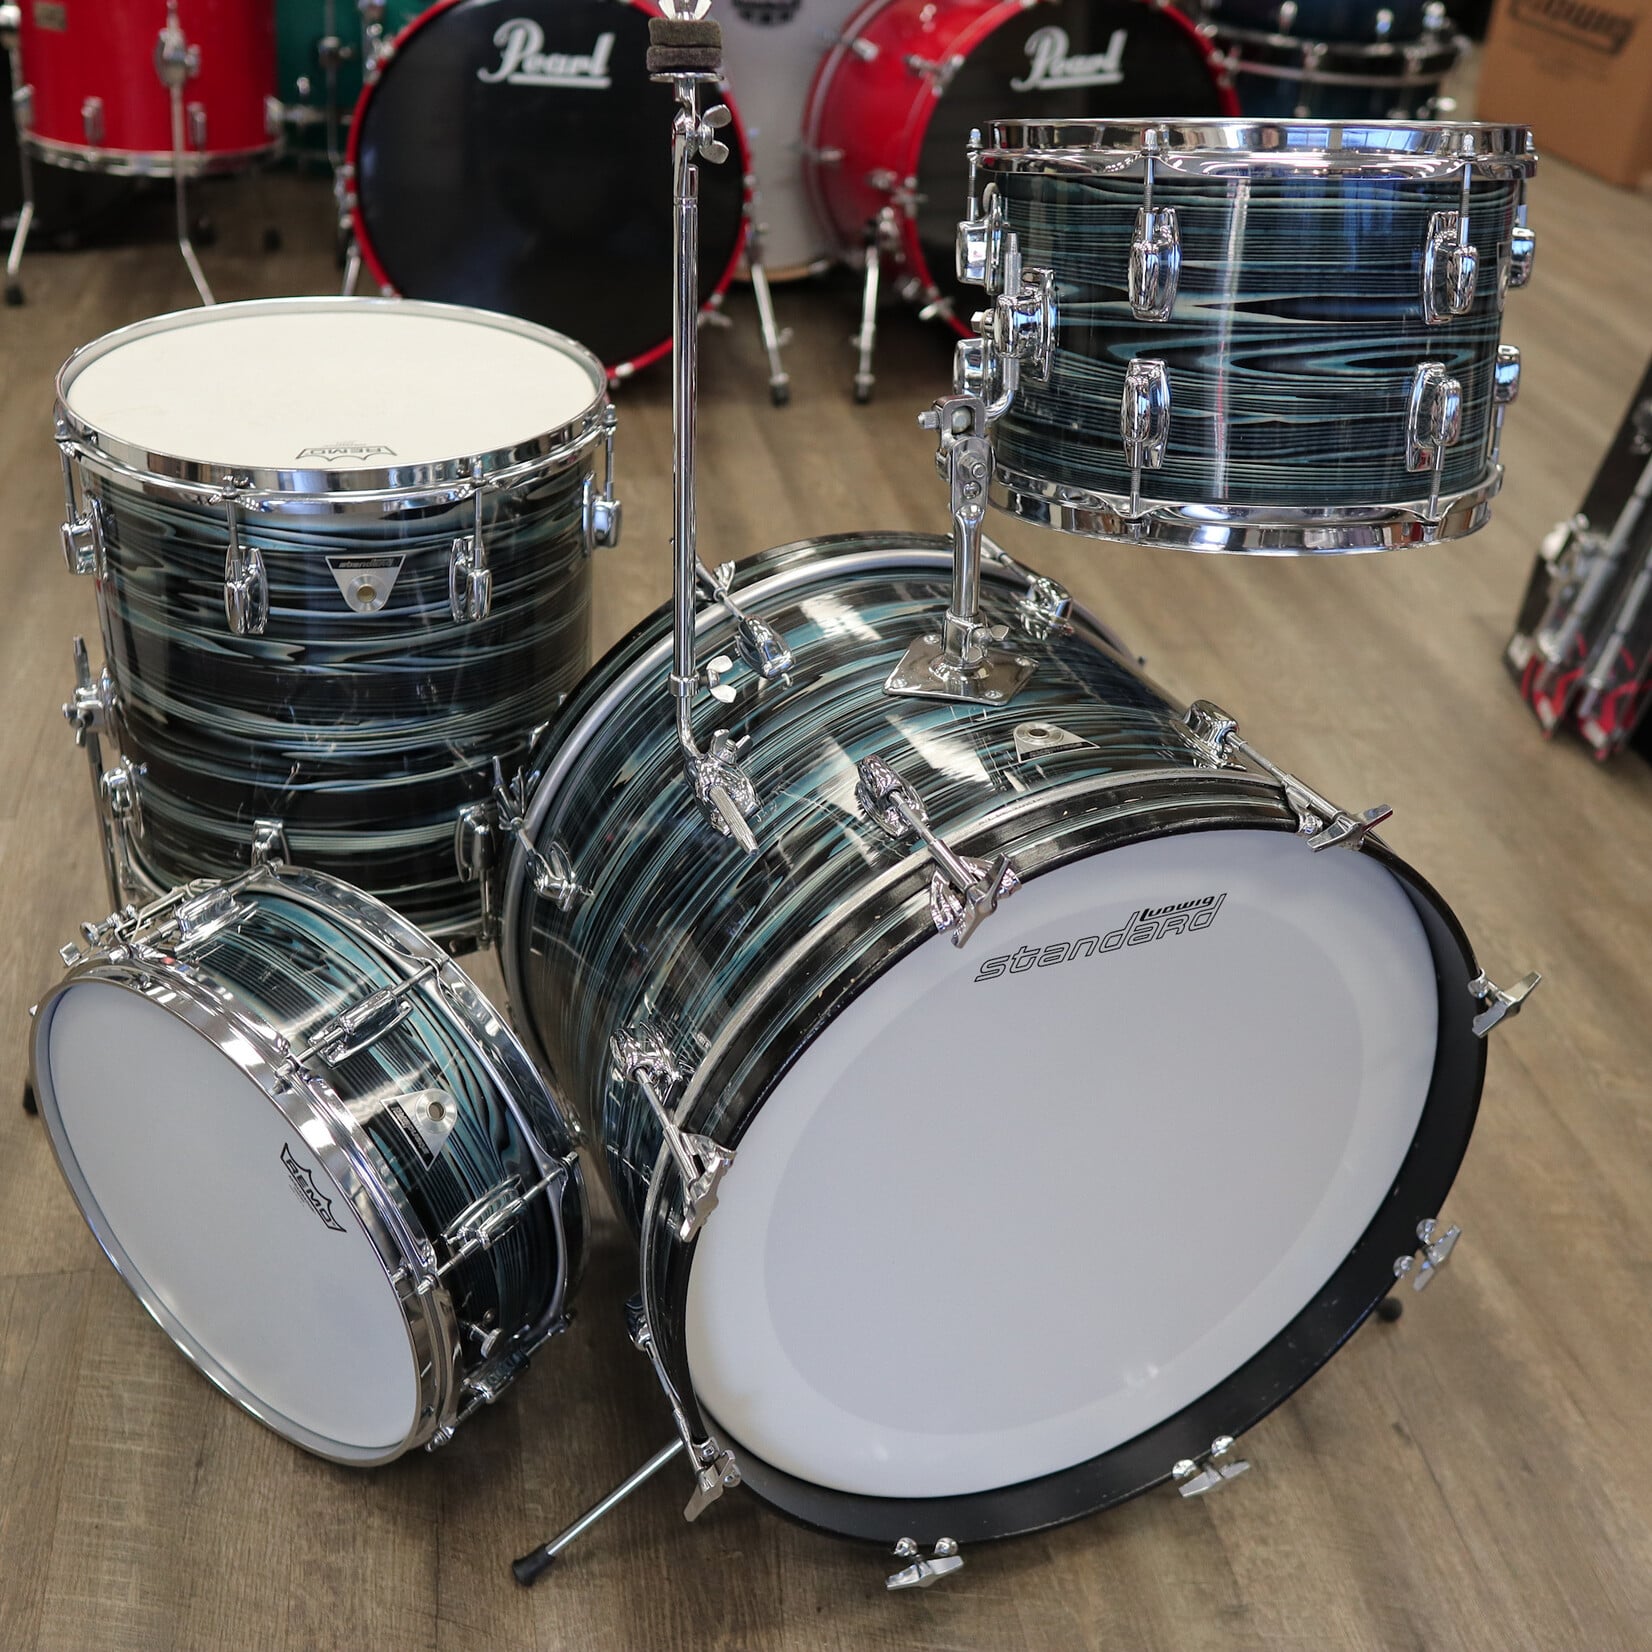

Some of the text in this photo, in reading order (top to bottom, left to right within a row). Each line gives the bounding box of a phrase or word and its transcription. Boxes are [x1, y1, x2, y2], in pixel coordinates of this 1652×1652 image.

[477, 17, 616, 89] Pearl
[1010, 25, 1128, 92] Pearl
[286, 1158, 333, 1223] REMO
